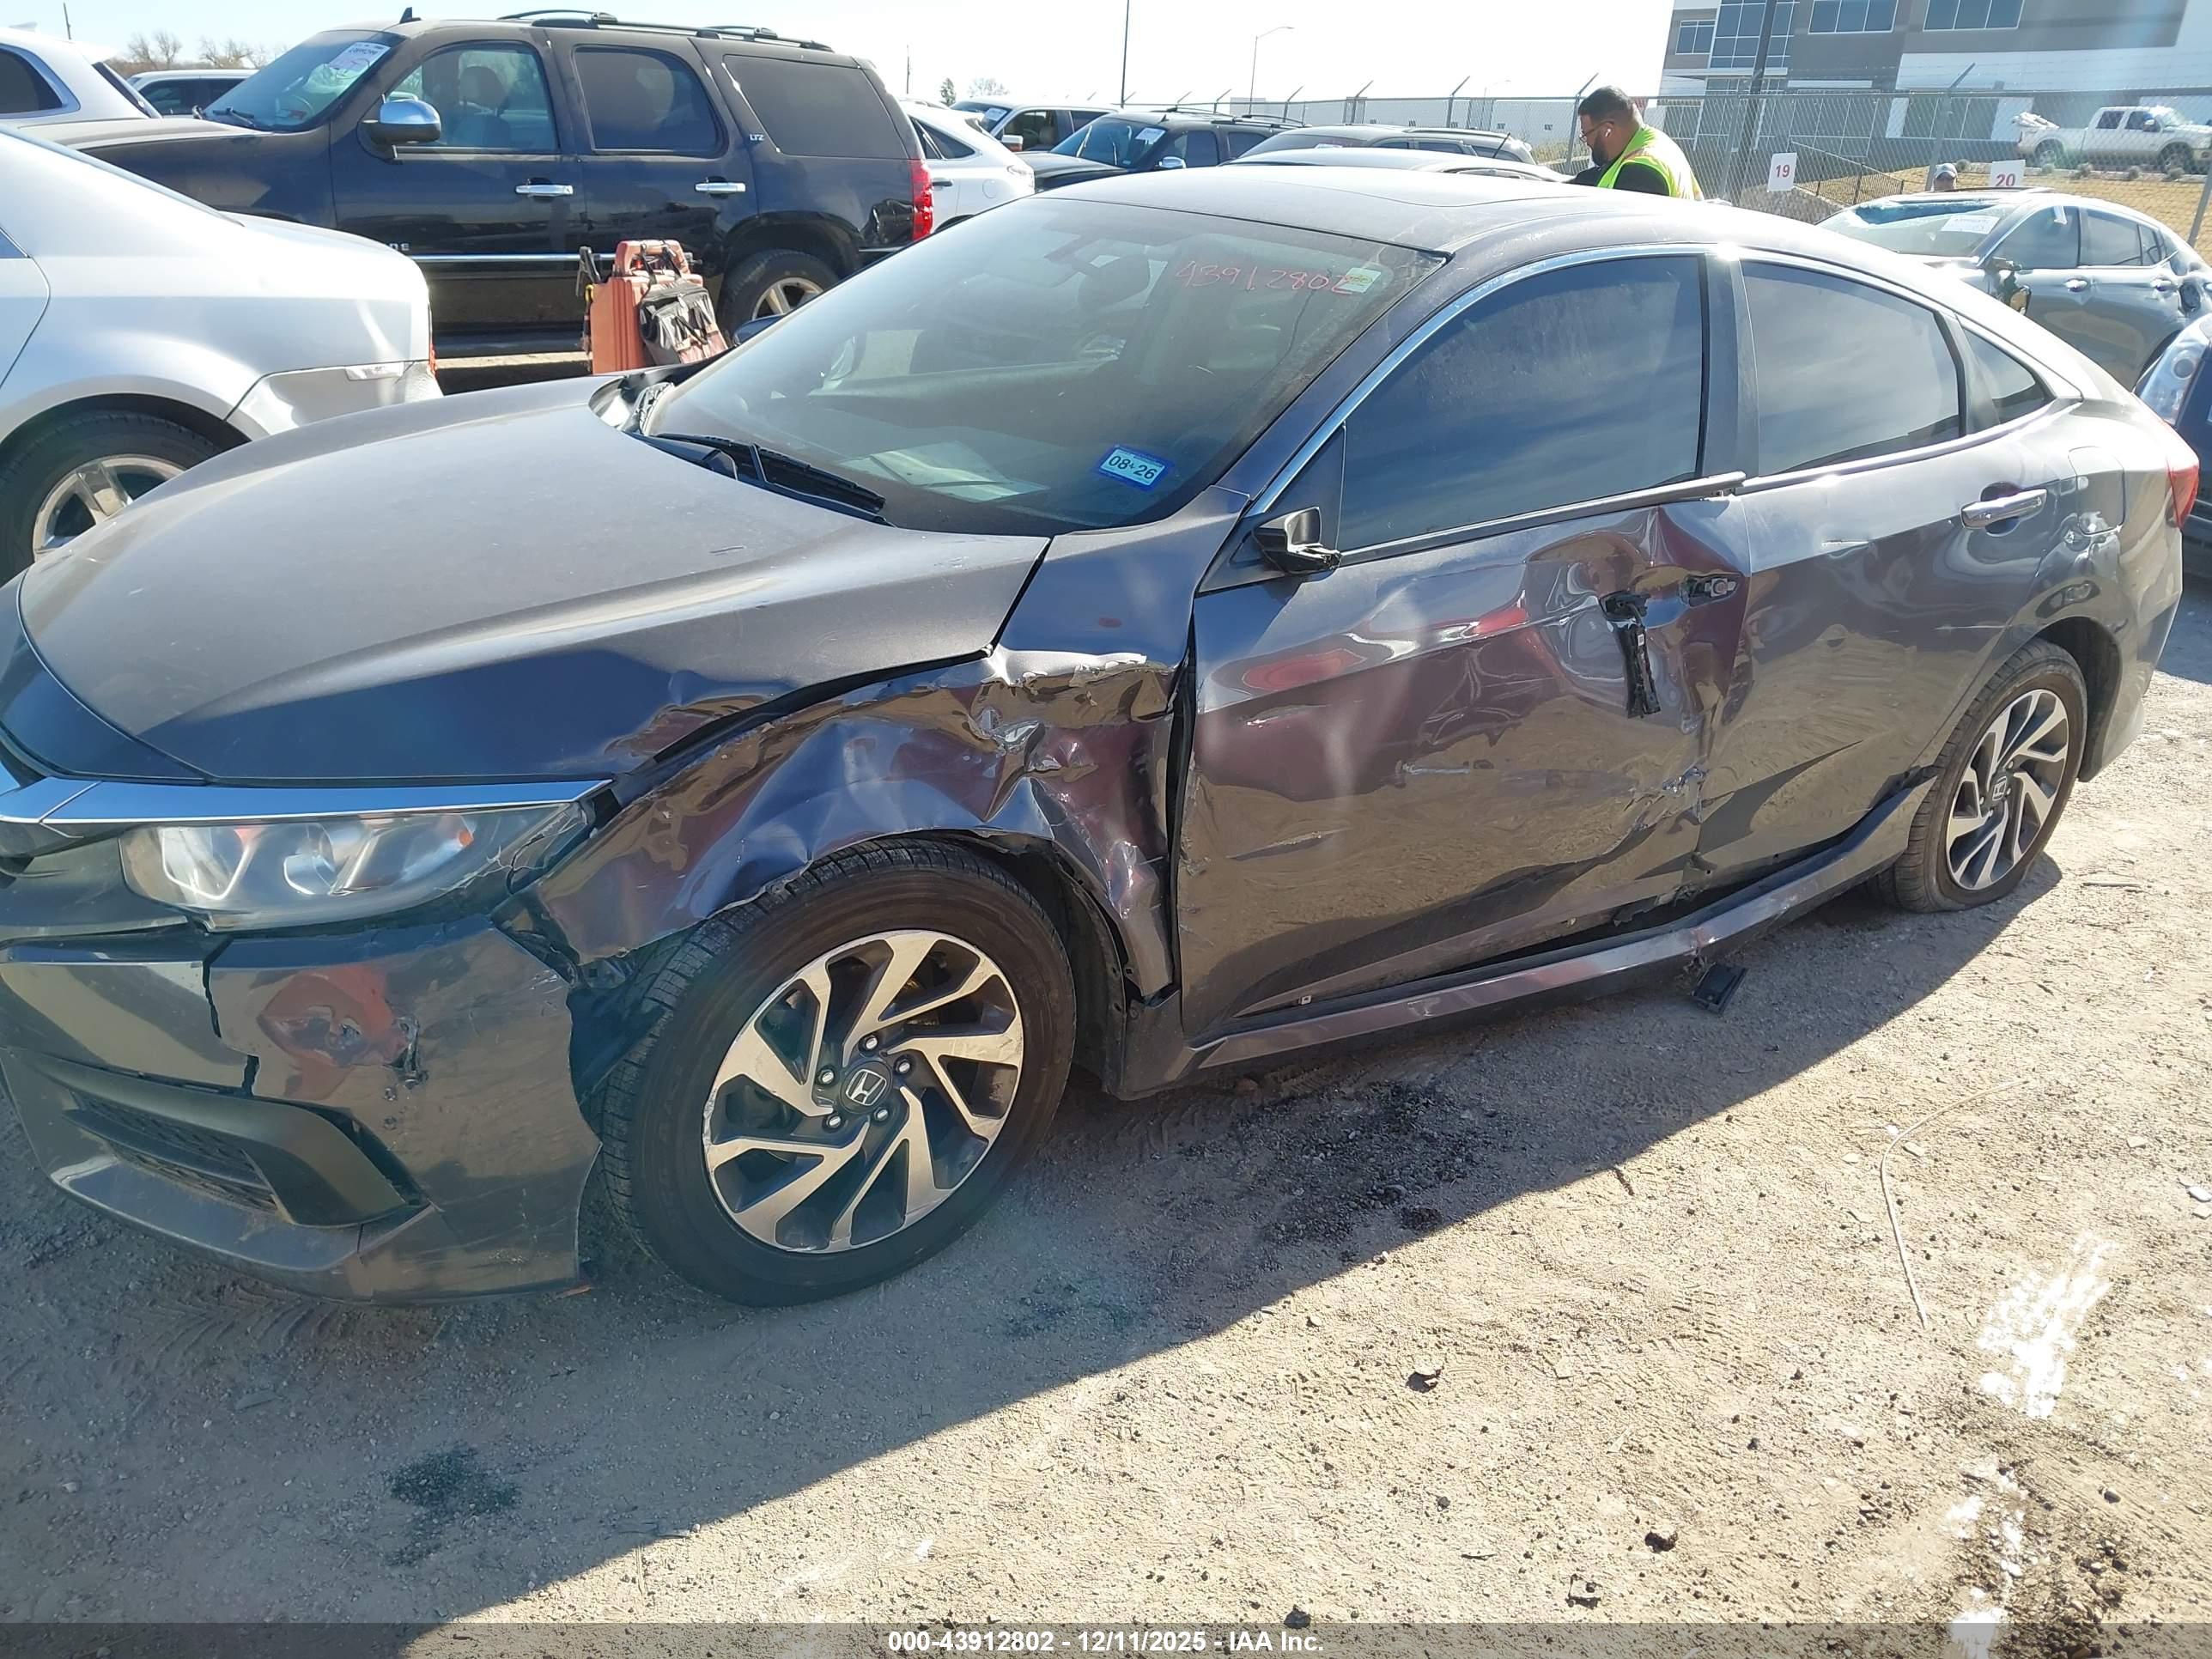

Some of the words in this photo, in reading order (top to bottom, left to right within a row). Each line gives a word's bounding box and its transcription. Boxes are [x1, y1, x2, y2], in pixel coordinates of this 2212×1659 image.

[1776, 164, 1790, 178] 19
[1996, 173, 2016, 186] 20
[1109, 455, 1131, 470] 08
[1133, 465, 1158, 479] 26
